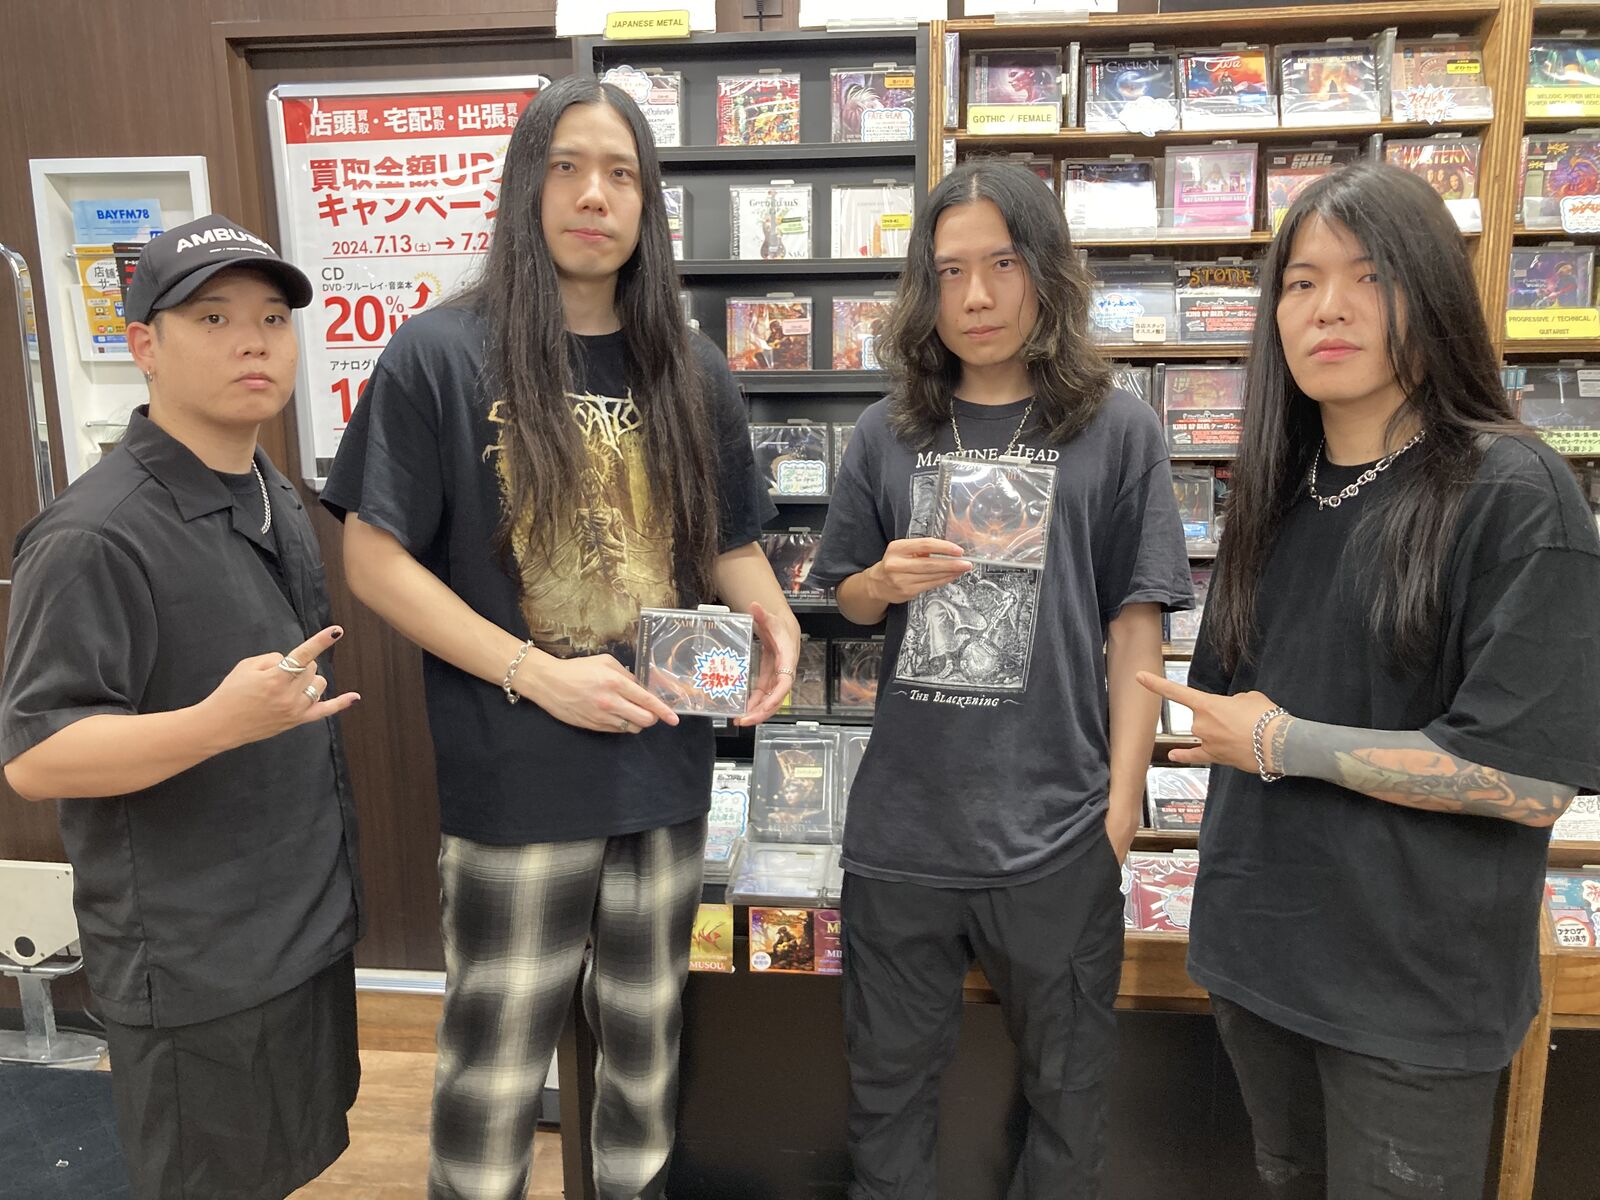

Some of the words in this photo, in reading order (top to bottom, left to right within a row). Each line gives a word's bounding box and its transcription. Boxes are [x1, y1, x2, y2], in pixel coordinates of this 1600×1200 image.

[612, 19, 654, 28] JAPANESE
[656, 18, 684, 26] METAL
[972, 115, 1005, 123] GOTHIC
[1017, 114, 1052, 122] FEMALE
[96, 209, 150, 220] BAYFM78
[461, 232, 493, 251] 7.2
[321, 267, 344, 281] CD
[97, 277, 120, 289] サー
[331, 377, 369, 423] 1
[909, 689, 929, 701] THE
